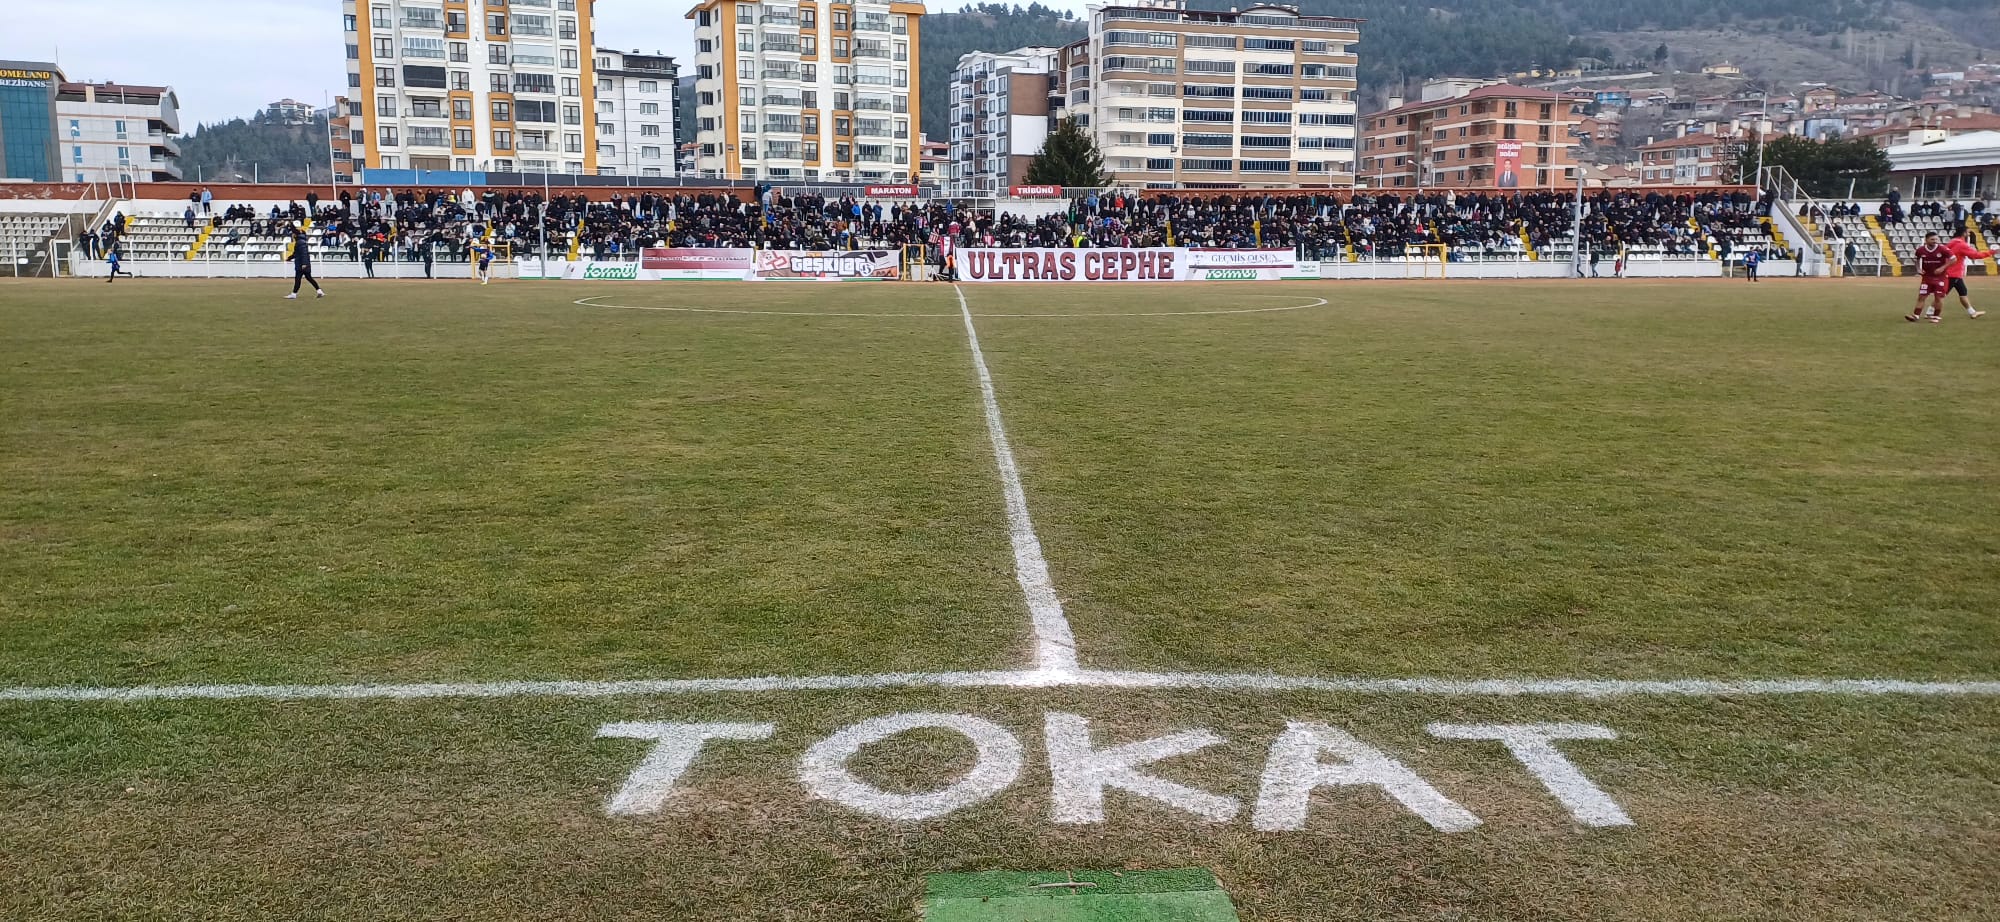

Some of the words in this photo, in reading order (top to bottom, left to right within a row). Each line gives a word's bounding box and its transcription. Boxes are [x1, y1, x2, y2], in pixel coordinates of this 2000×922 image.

[1016, 185, 1054, 194] TRİBÜNÜ
[583, 263, 639, 279] formül
[967, 252, 1076, 279] ULTRAS
[1084, 252, 1174, 279] CEPHE
[596, 710, 1634, 831] TOKAT
